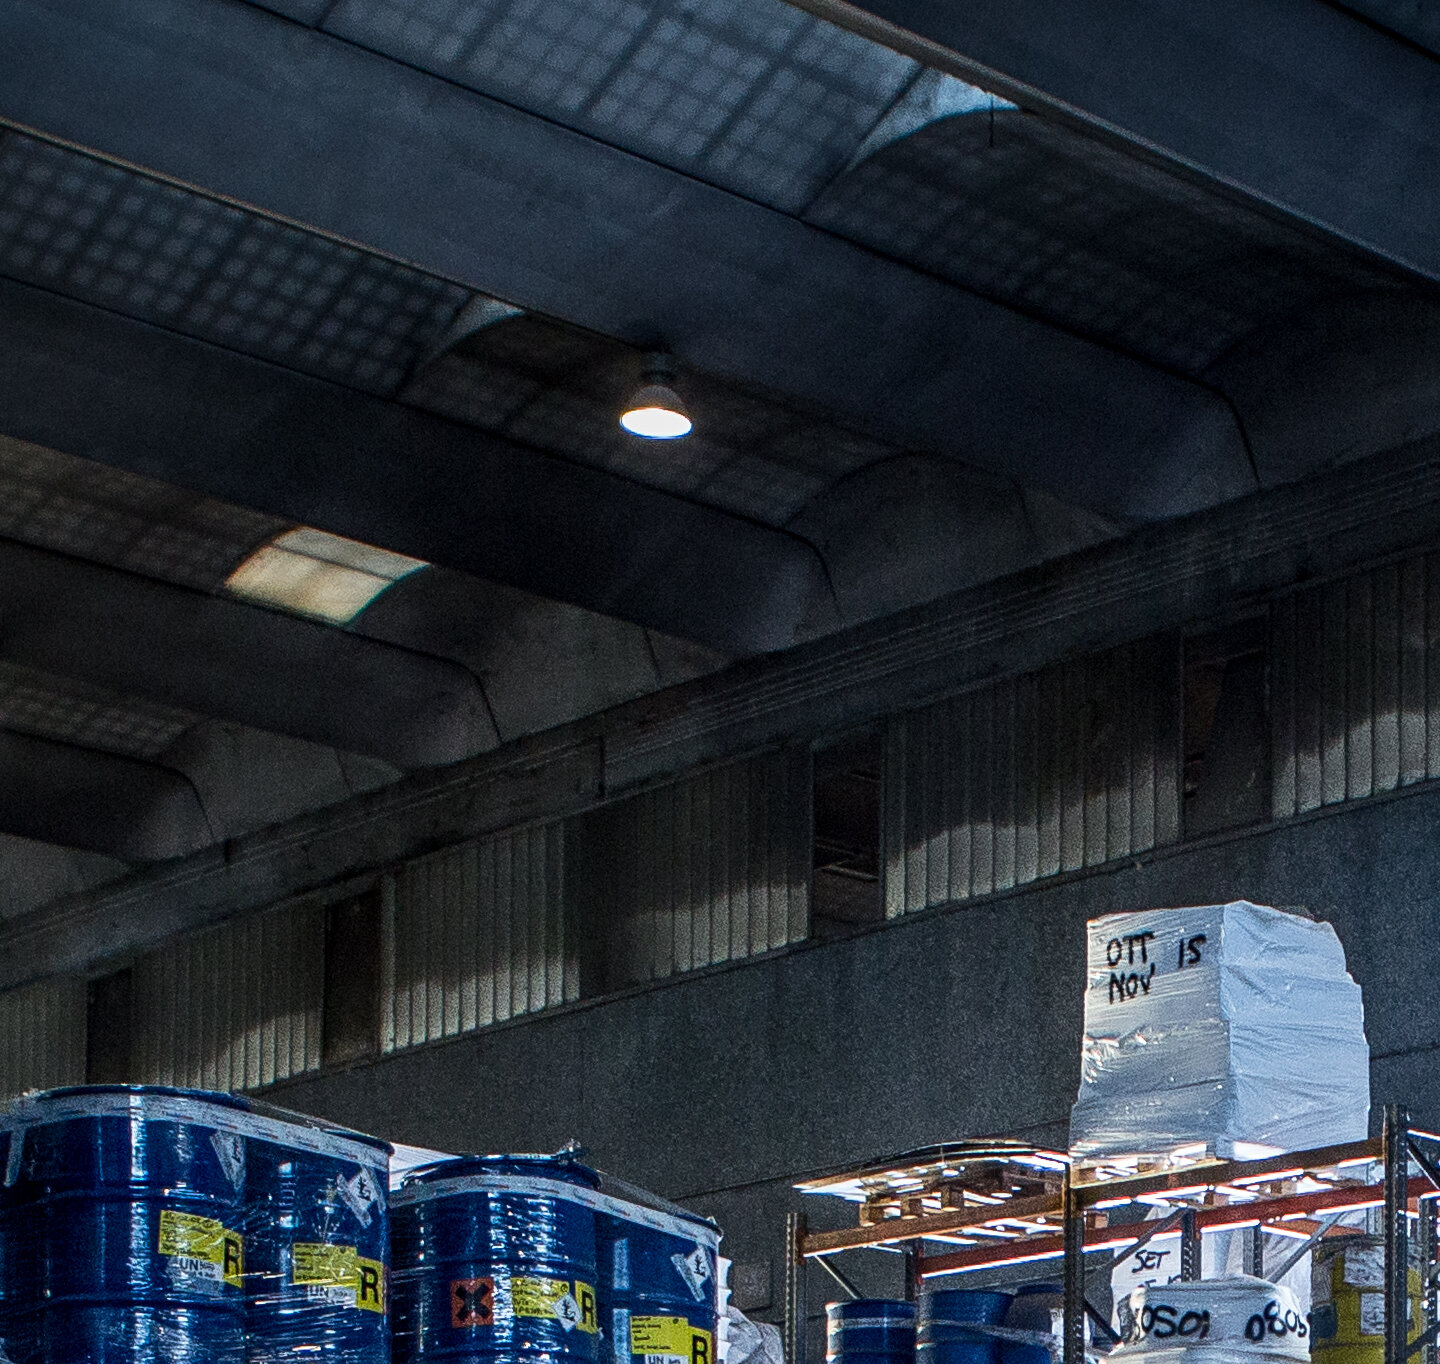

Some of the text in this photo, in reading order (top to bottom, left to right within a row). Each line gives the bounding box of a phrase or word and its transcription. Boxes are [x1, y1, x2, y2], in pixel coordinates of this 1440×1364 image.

[1107, 930, 1155, 966] OTT
[1109, 962, 1156, 1005] NOV
[224, 1237, 240, 1275] R
[1131, 1249, 1171, 1274] SET
[360, 1265, 379, 1303] R
